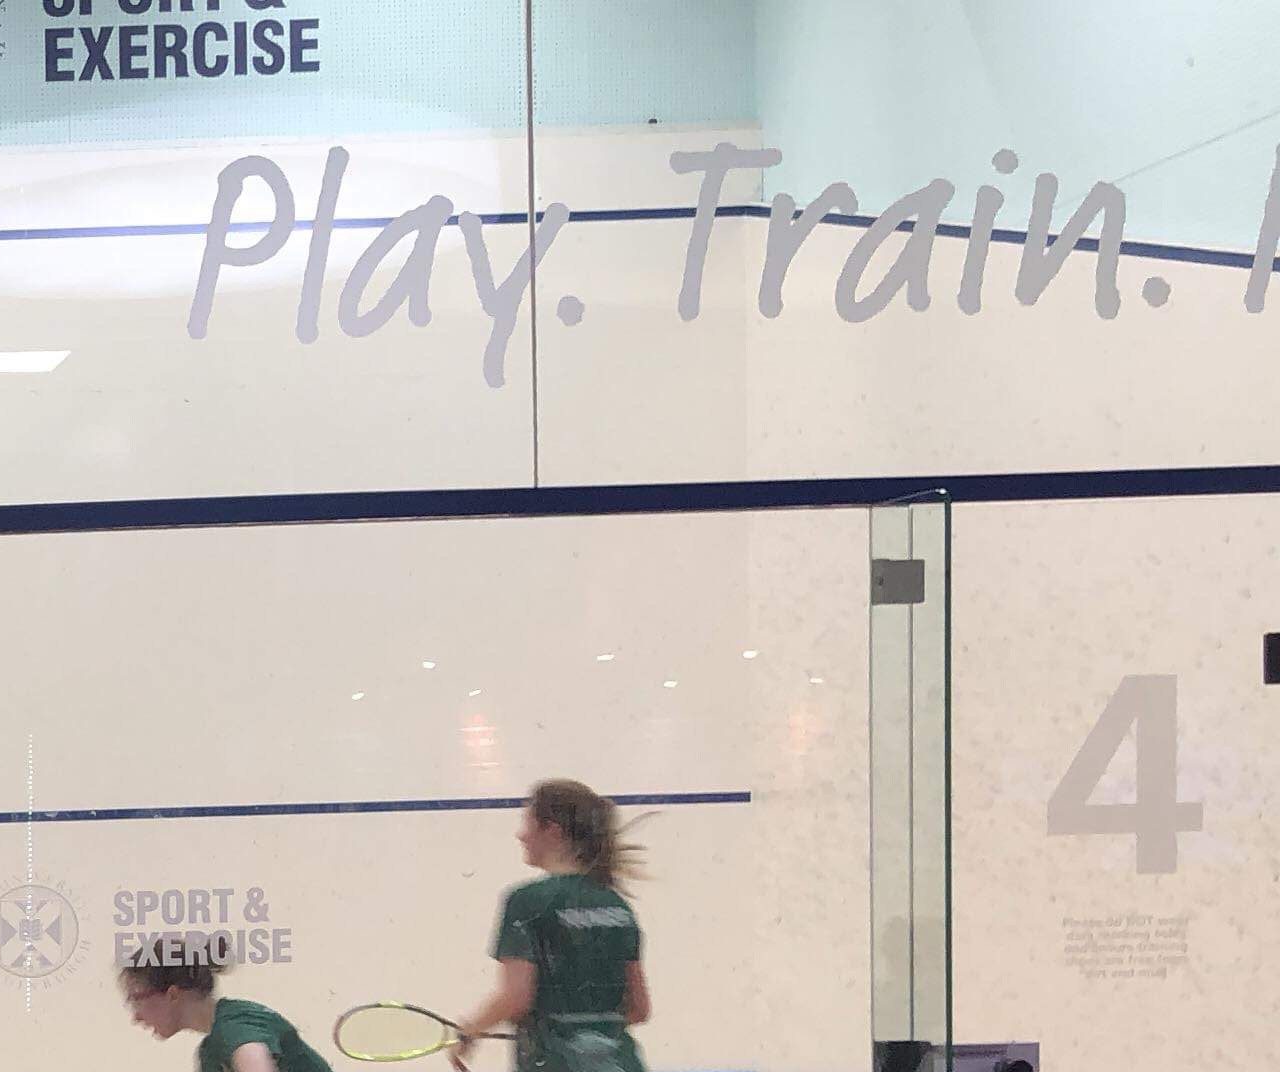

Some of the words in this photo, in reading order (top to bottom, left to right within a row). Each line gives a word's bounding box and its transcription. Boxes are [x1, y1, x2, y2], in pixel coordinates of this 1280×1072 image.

[44, 18, 321, 83] EXERCISE
[186, 145, 585, 388] Play.
[669, 142, 1172, 323] Train.
[1046, 673, 1204, 875] 4
[113, 887, 235, 927] SPORT
[242, 886, 271, 924] &
[114, 927, 293, 968] EXERCISE
